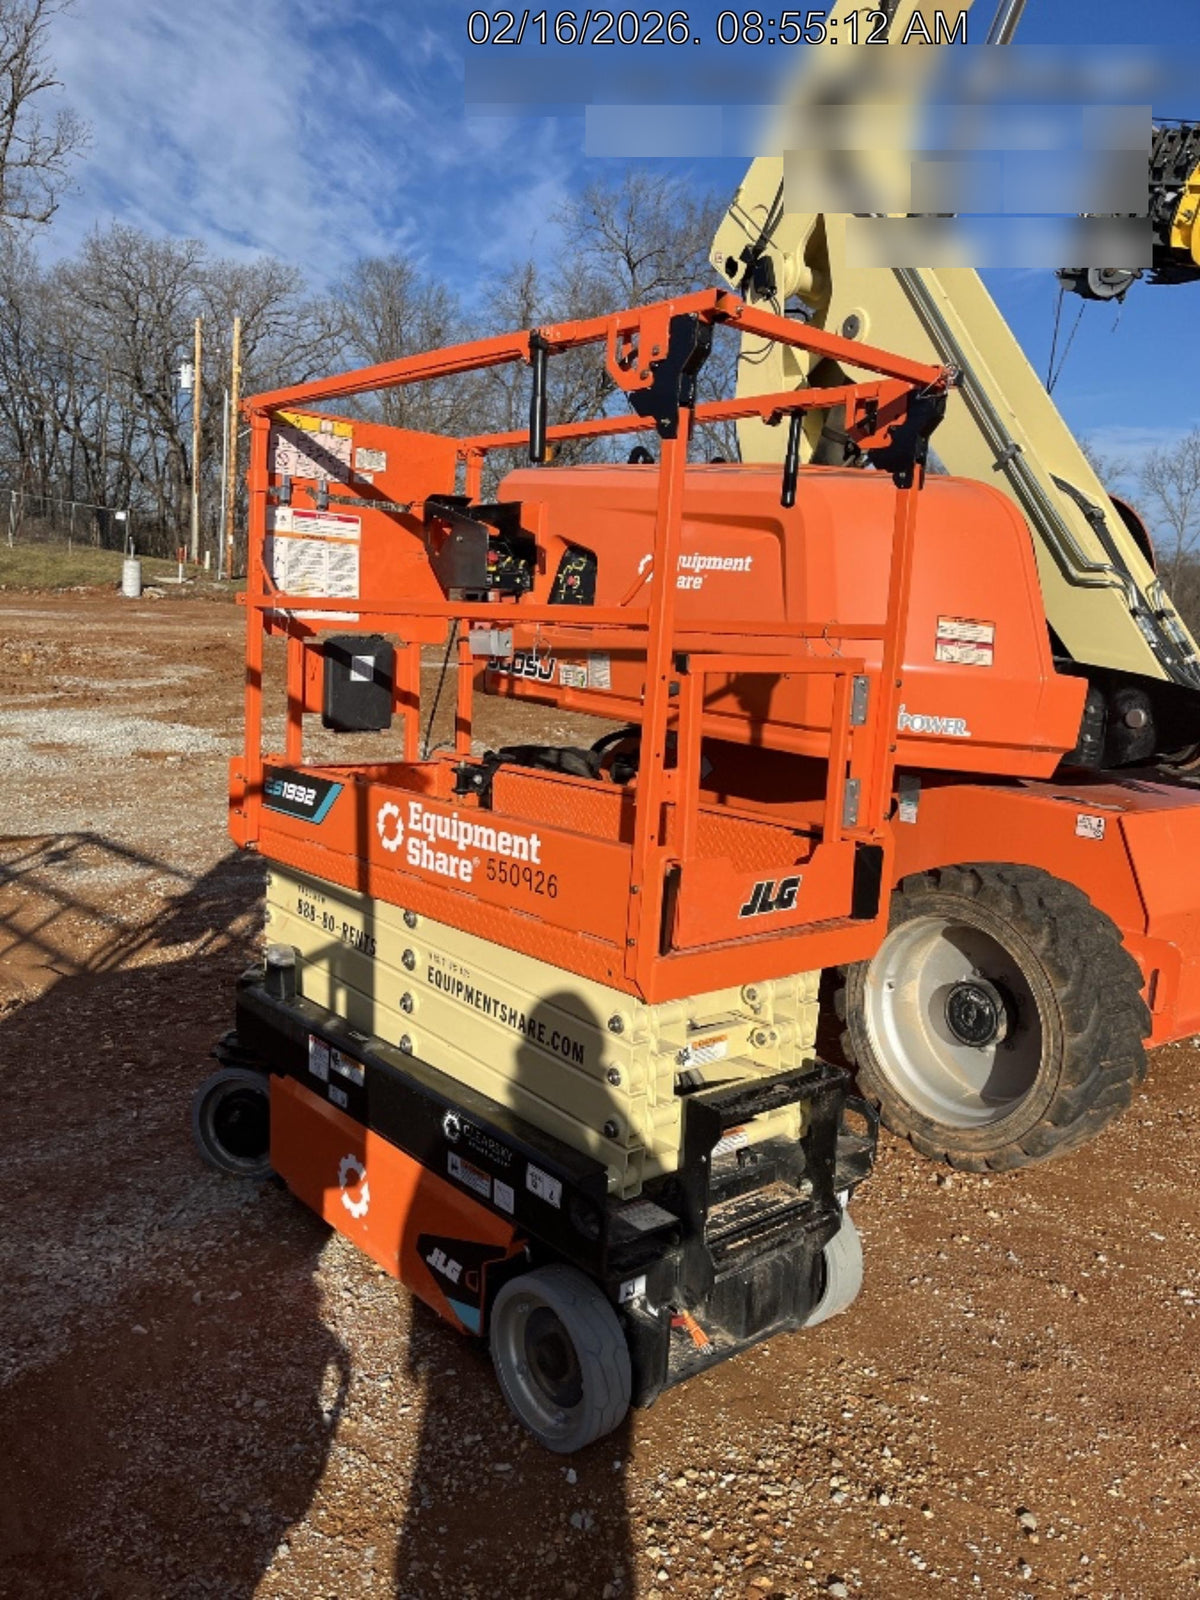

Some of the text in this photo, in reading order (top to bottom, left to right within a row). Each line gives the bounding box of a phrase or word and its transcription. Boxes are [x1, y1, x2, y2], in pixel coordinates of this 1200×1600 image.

[408, 801, 541, 865] Equipment
[486, 858, 558, 899] 550926
[738, 874, 803, 919] JLG
[427, 964, 585, 1065] EQUIPMENTSHARE.COM
[426, 1247, 463, 1284] JLG
